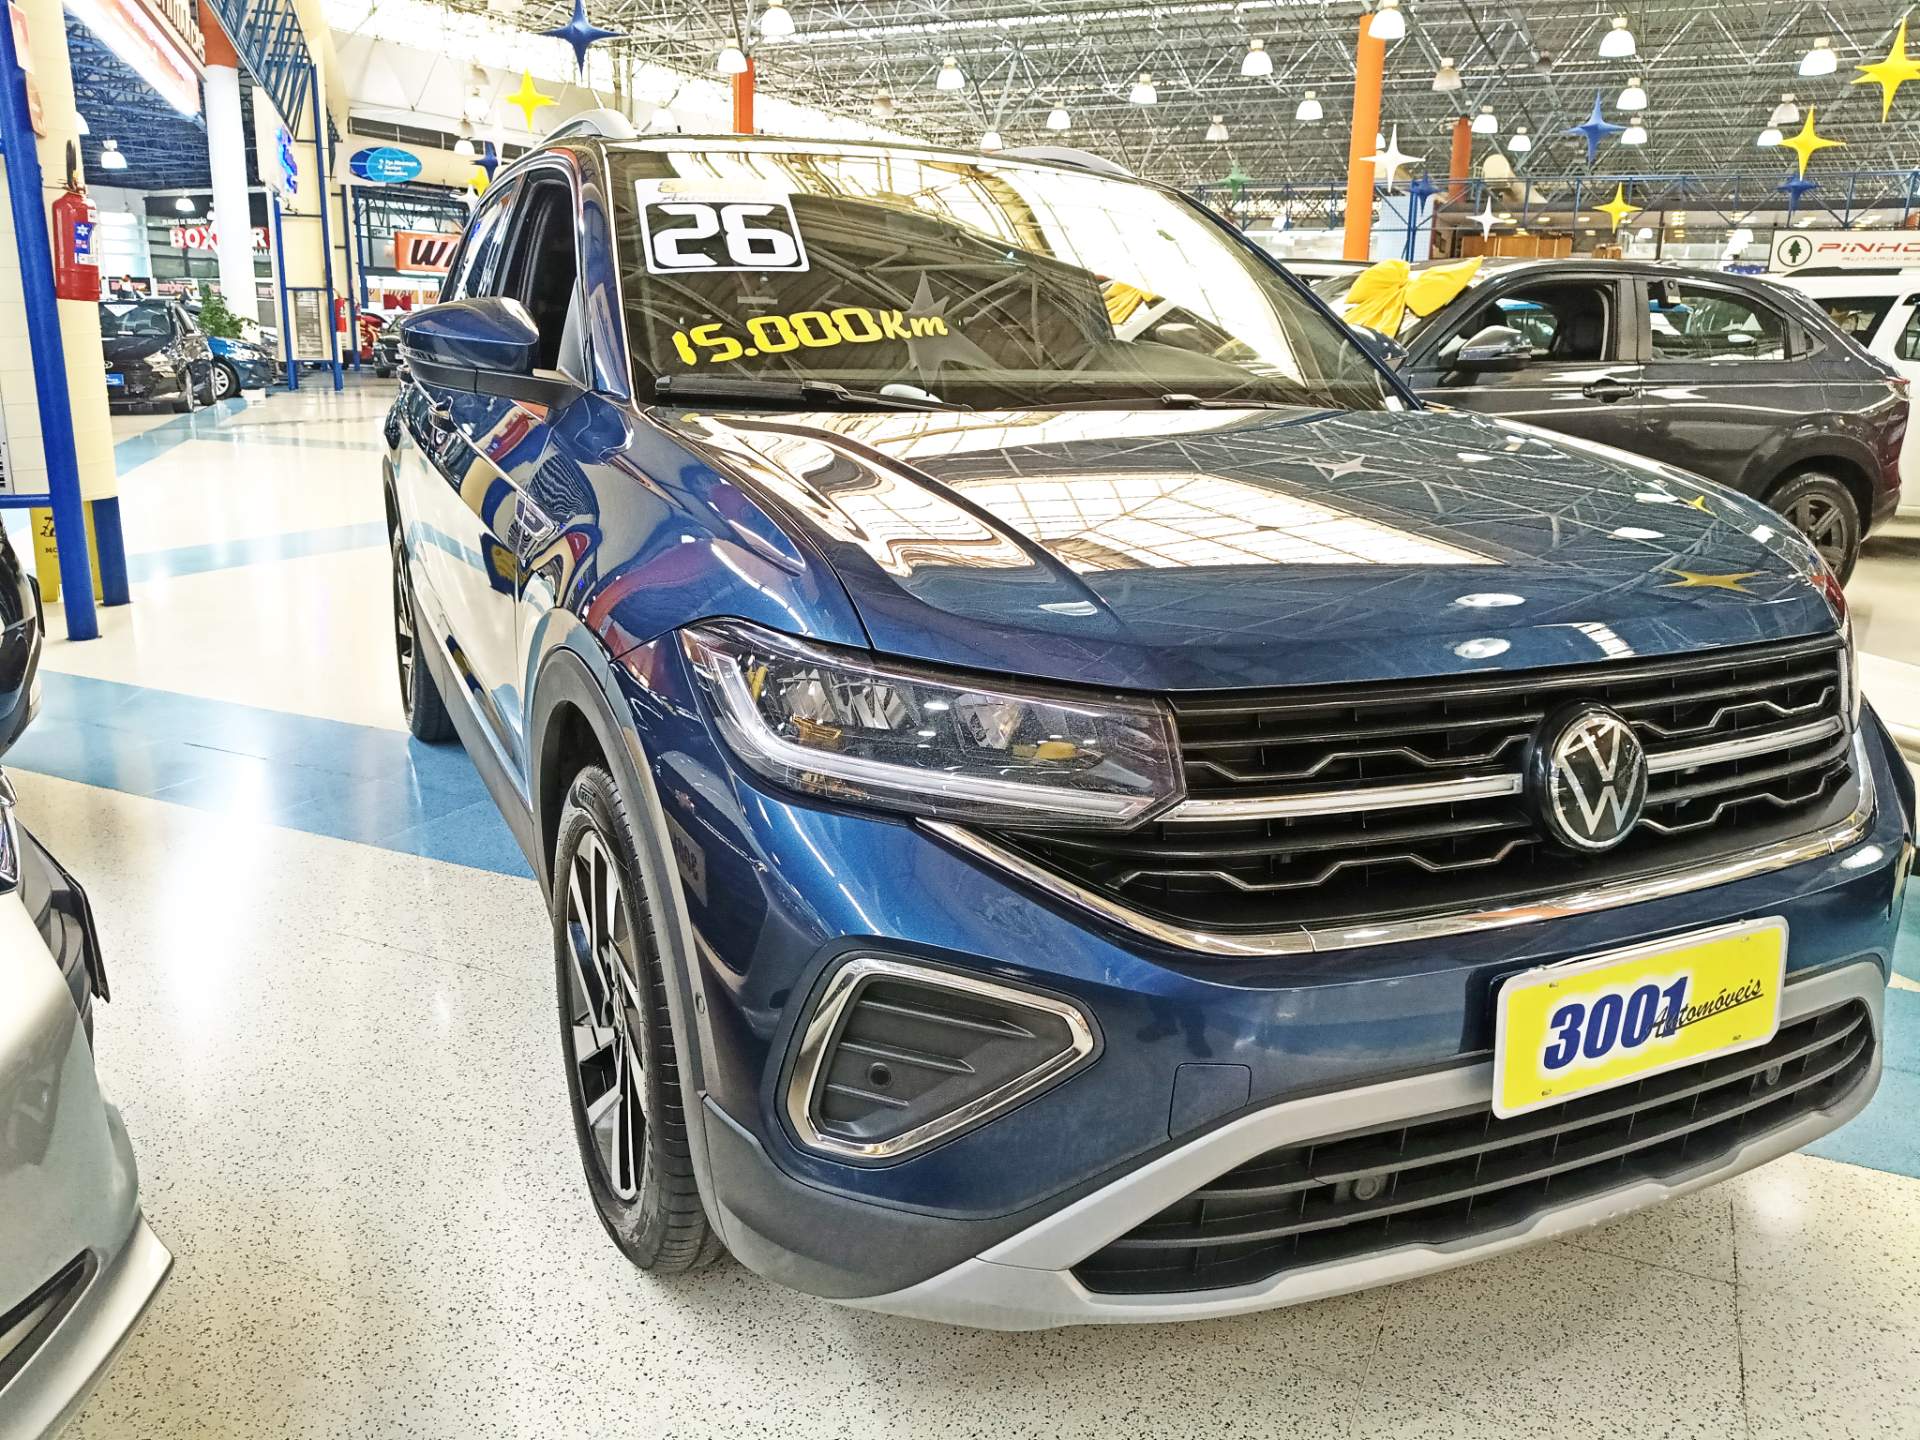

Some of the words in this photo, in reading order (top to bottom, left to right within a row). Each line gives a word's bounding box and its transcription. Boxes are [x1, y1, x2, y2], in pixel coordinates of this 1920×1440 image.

[653, 203, 798, 268] 26
[1543, 976, 1689, 1070] 3001
[1647, 978, 1763, 1038] Automóveis
